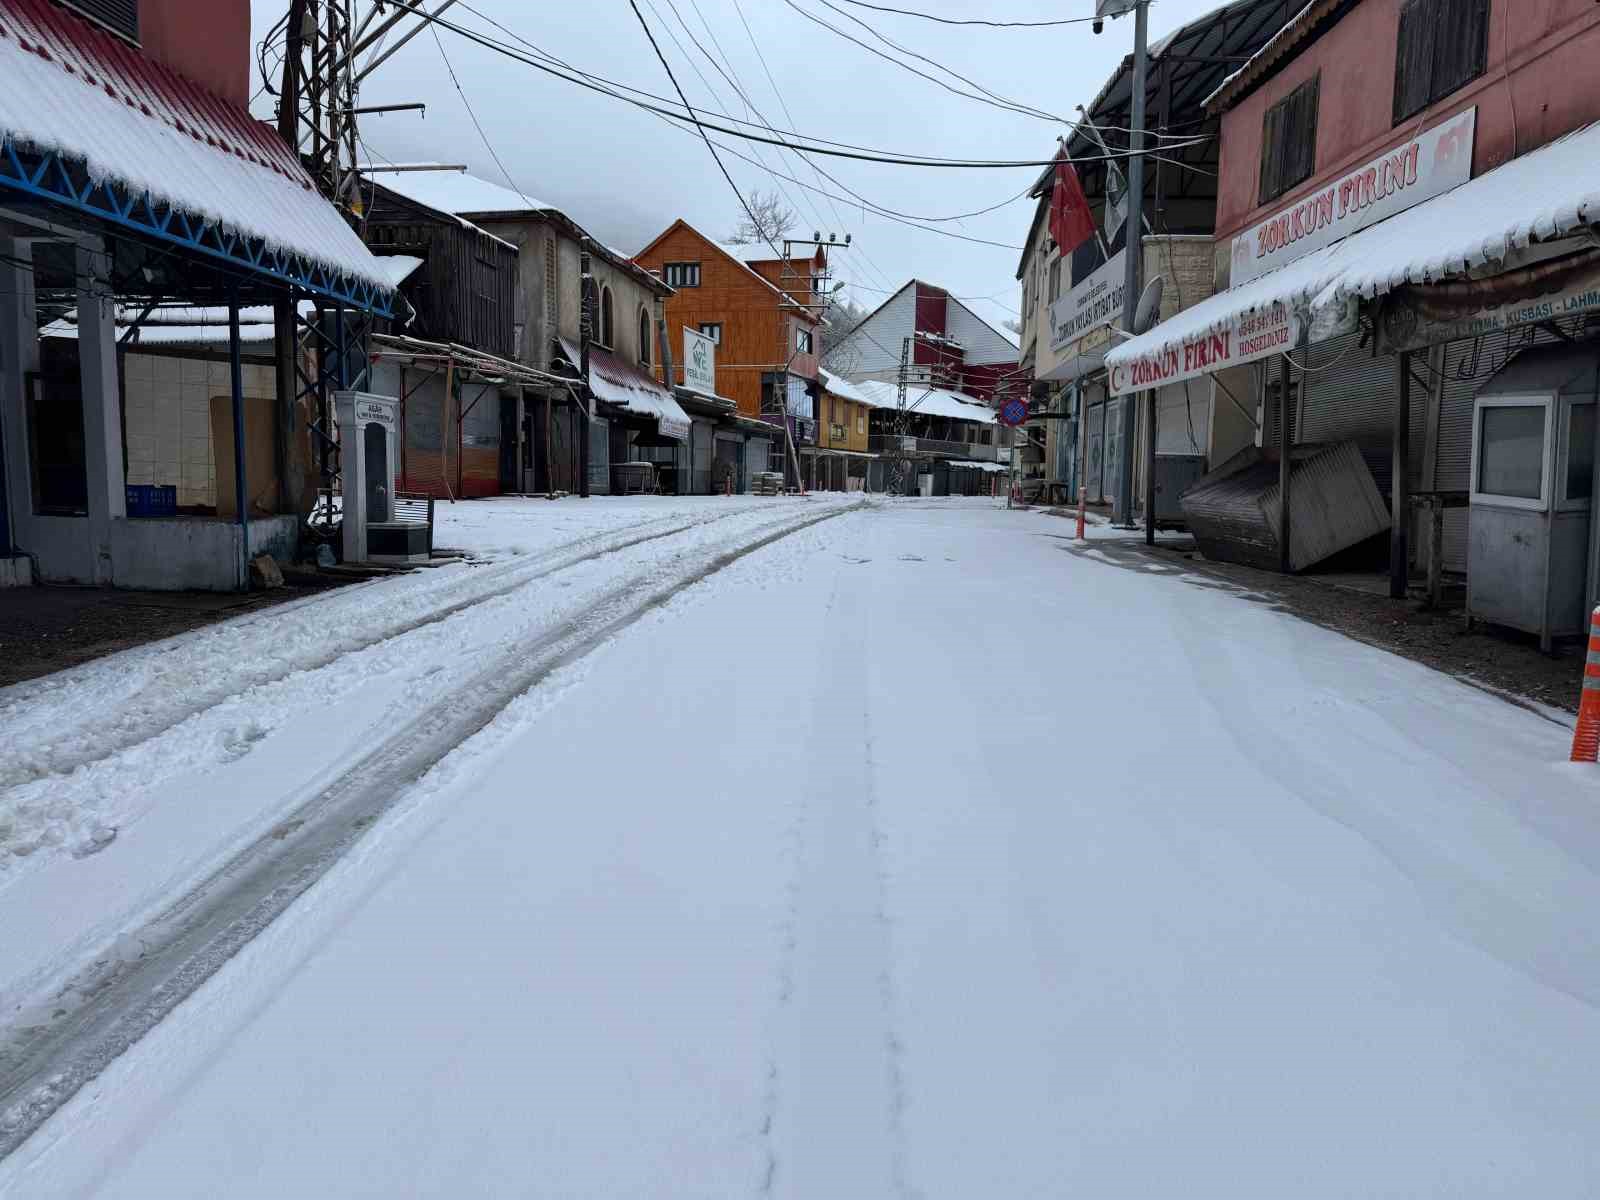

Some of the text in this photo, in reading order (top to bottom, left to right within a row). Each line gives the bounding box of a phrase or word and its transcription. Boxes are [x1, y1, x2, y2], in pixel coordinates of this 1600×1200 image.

[1256, 189, 1336, 259] ZORKUN
[1130, 330, 1231, 386] ZORKUN FIRINI
